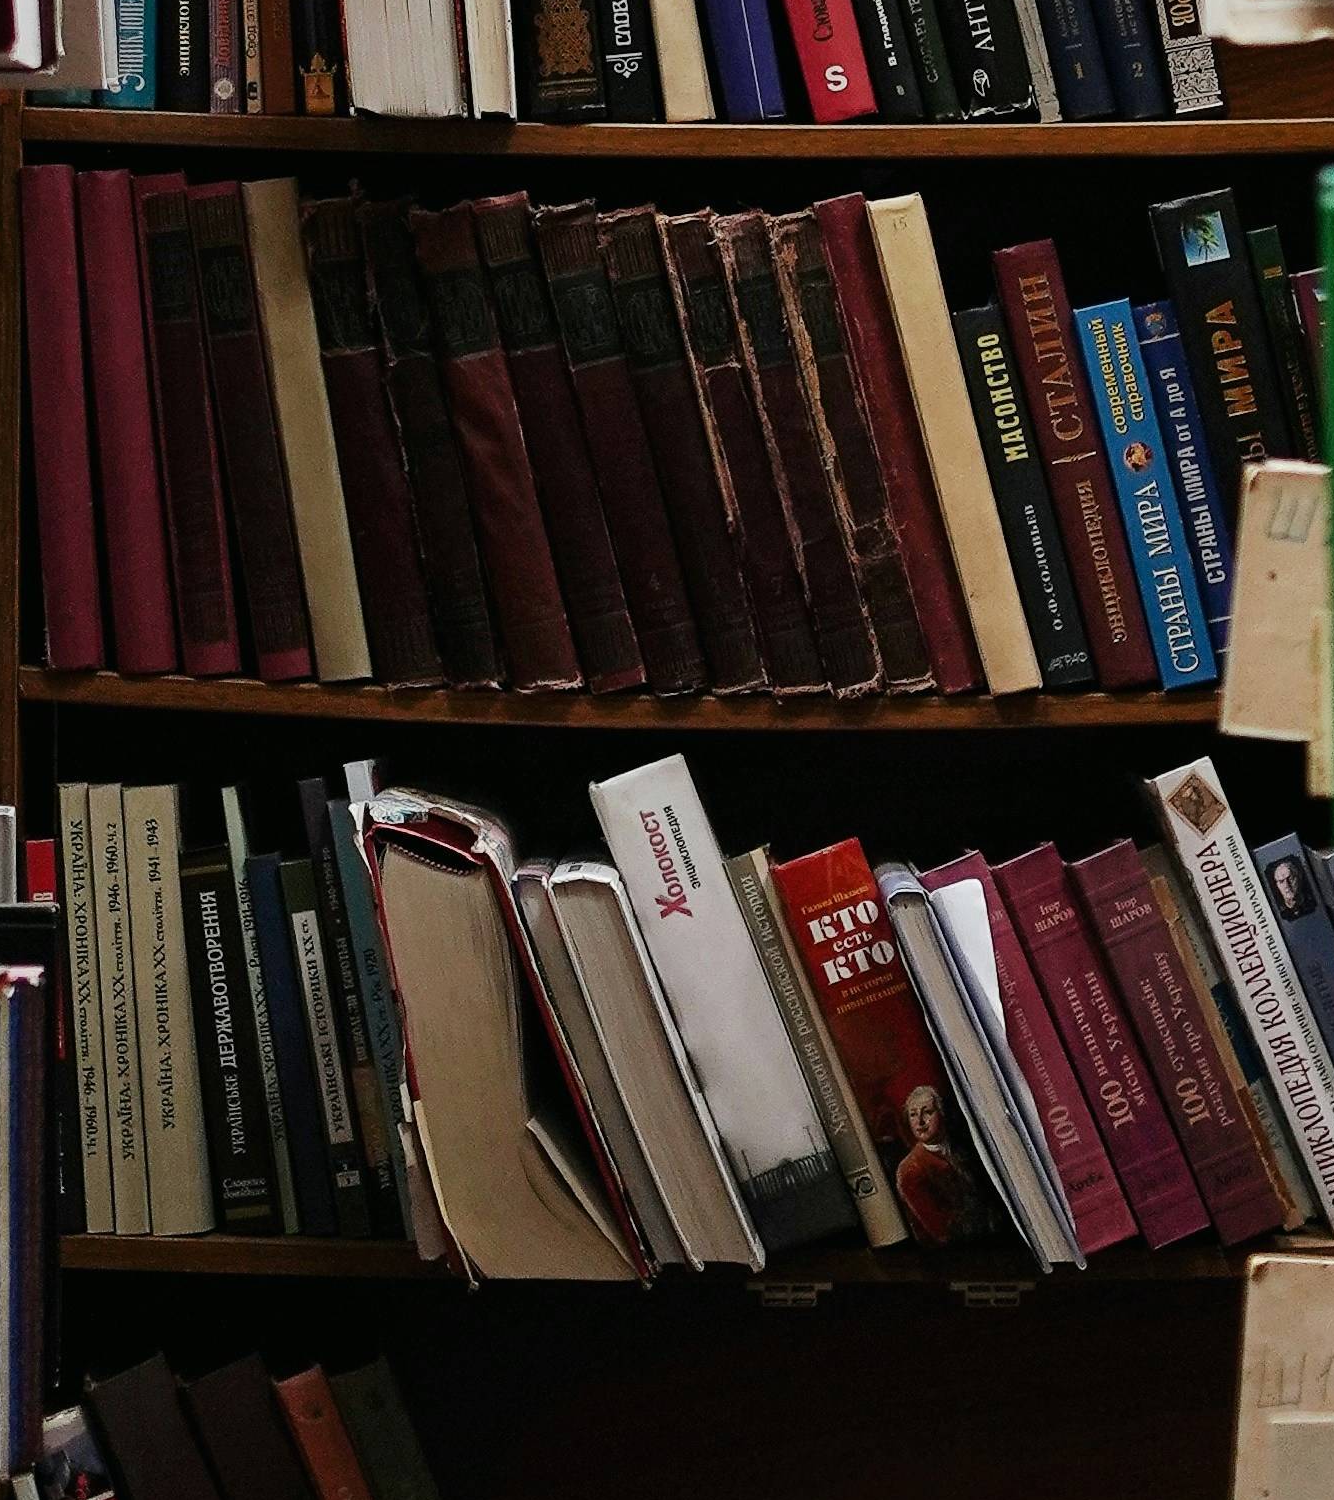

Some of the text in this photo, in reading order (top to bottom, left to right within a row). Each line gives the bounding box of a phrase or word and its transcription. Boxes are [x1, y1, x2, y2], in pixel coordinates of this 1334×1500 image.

[1075, 61, 1084, 79] 1
[1131, 61, 1144, 78] 2
[977, 333, 1029, 462] МАСОНСТВО
[1018, 274, 1084, 441] СТАЛИН
[1087, 318, 1130, 435] современный
[1111, 322, 1146, 422] справочник
[1206, 309, 1257, 417] МИРА
[1158, 365, 1226, 584] СТРАНЫ МИРА от А до Я
[1076, 482, 1128, 643] ЭНЦИКЛОПЕДИЯ
[1133, 479, 1199, 672] СТРАНЫ МИРА
[807, 899, 879, 945] КТО
[820, 939, 896, 986] КТО
[832, 930, 874, 953] есть
[1034, 906, 1076, 933] ШАРОВ
[1109, 903, 1153, 929] ШАРОВ
[1195, 840, 1287, 1032] КОЛЛЕКЦИОНЕРА
[199, 890, 245, 1154] УКРАЇНСЬКЕ ДЕРЖАВОТВОРЕННЯ
[304, 958, 330, 1037] ІСТОРИКИ
[740, 874, 848, 1137] Хронология российской истории
[1063, 977, 1134, 1129] 100 визначних
[1084, 971, 1146, 1106] місць України
[1153, 952, 1236, 1127] роздуми про Україну
[319, 1041, 345, 1133] УКРАЇНСЬКІ
[1175, 1077, 1211, 1126] 100
